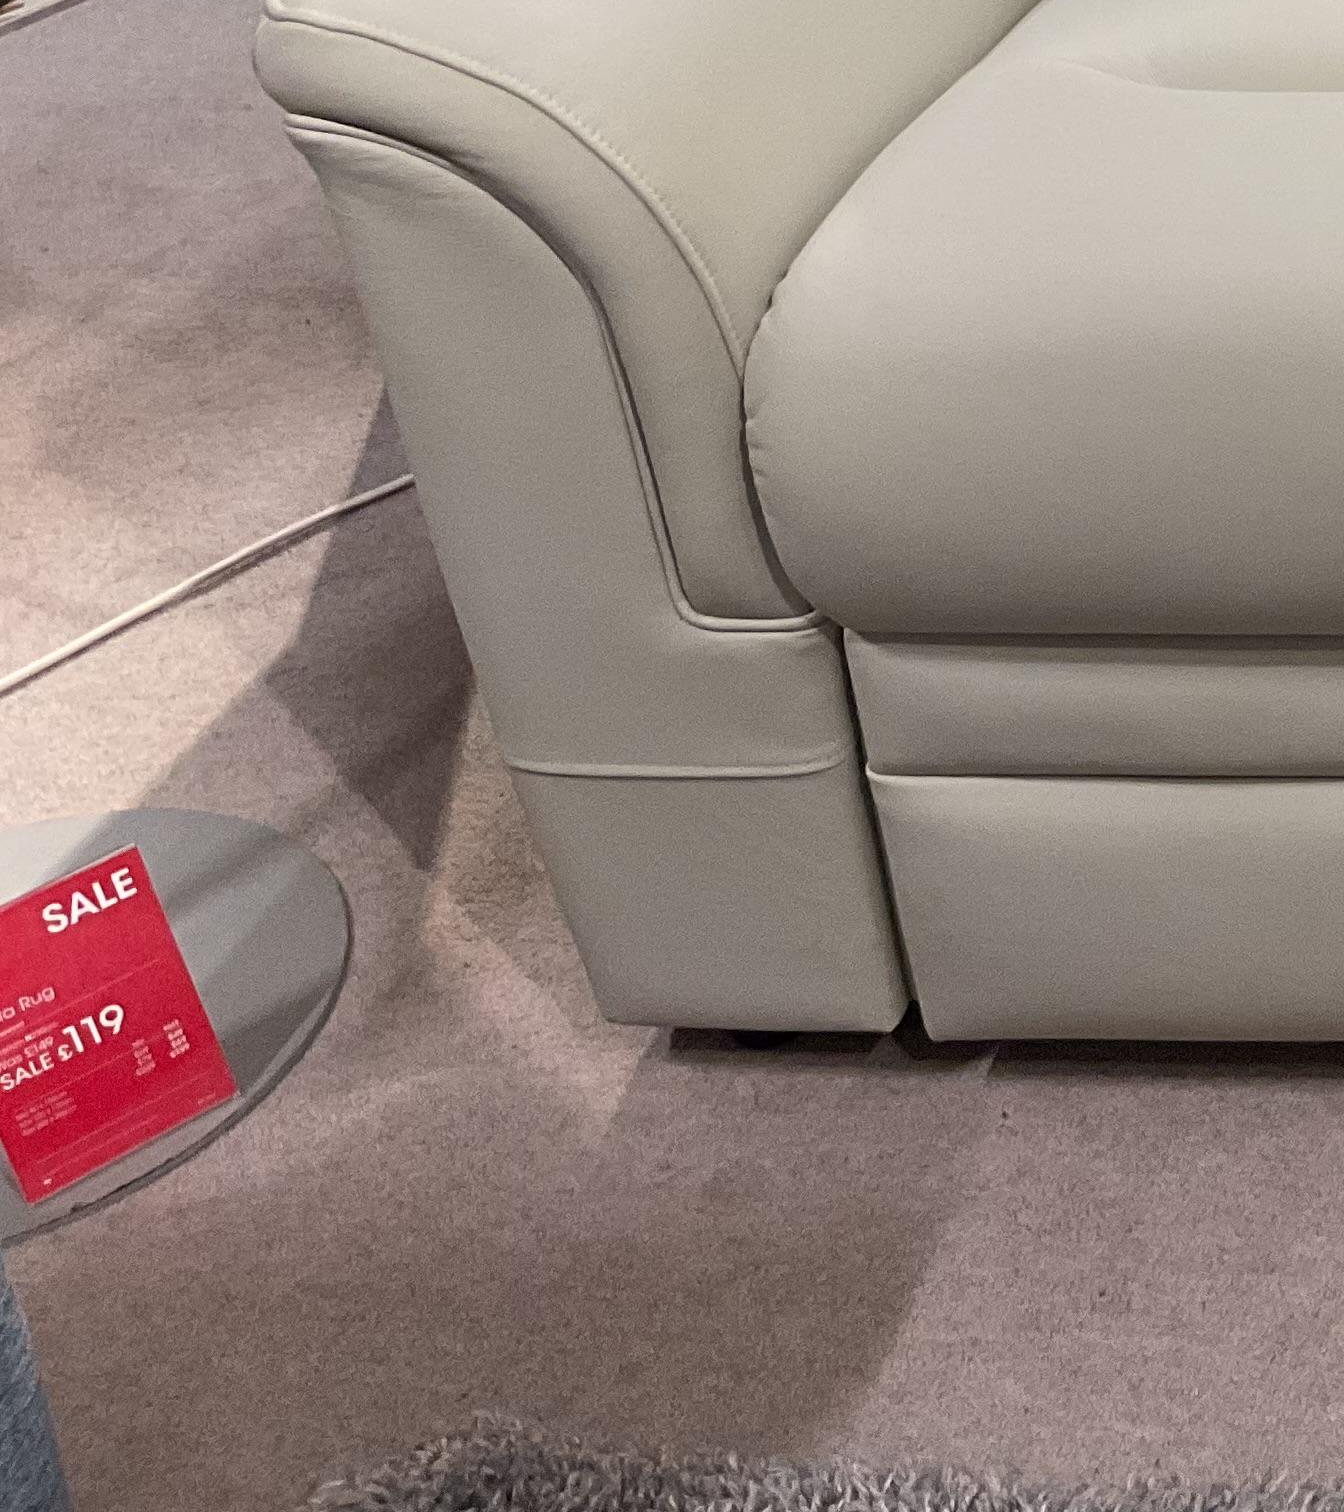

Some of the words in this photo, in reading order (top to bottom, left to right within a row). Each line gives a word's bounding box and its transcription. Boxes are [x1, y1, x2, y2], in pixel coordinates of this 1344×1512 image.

[42, 867, 138, 933] SALE
[18, 987, 56, 1011] Rug
[0, 1050, 55, 1091] SALE
[57, 1004, 125, 1062] £119
